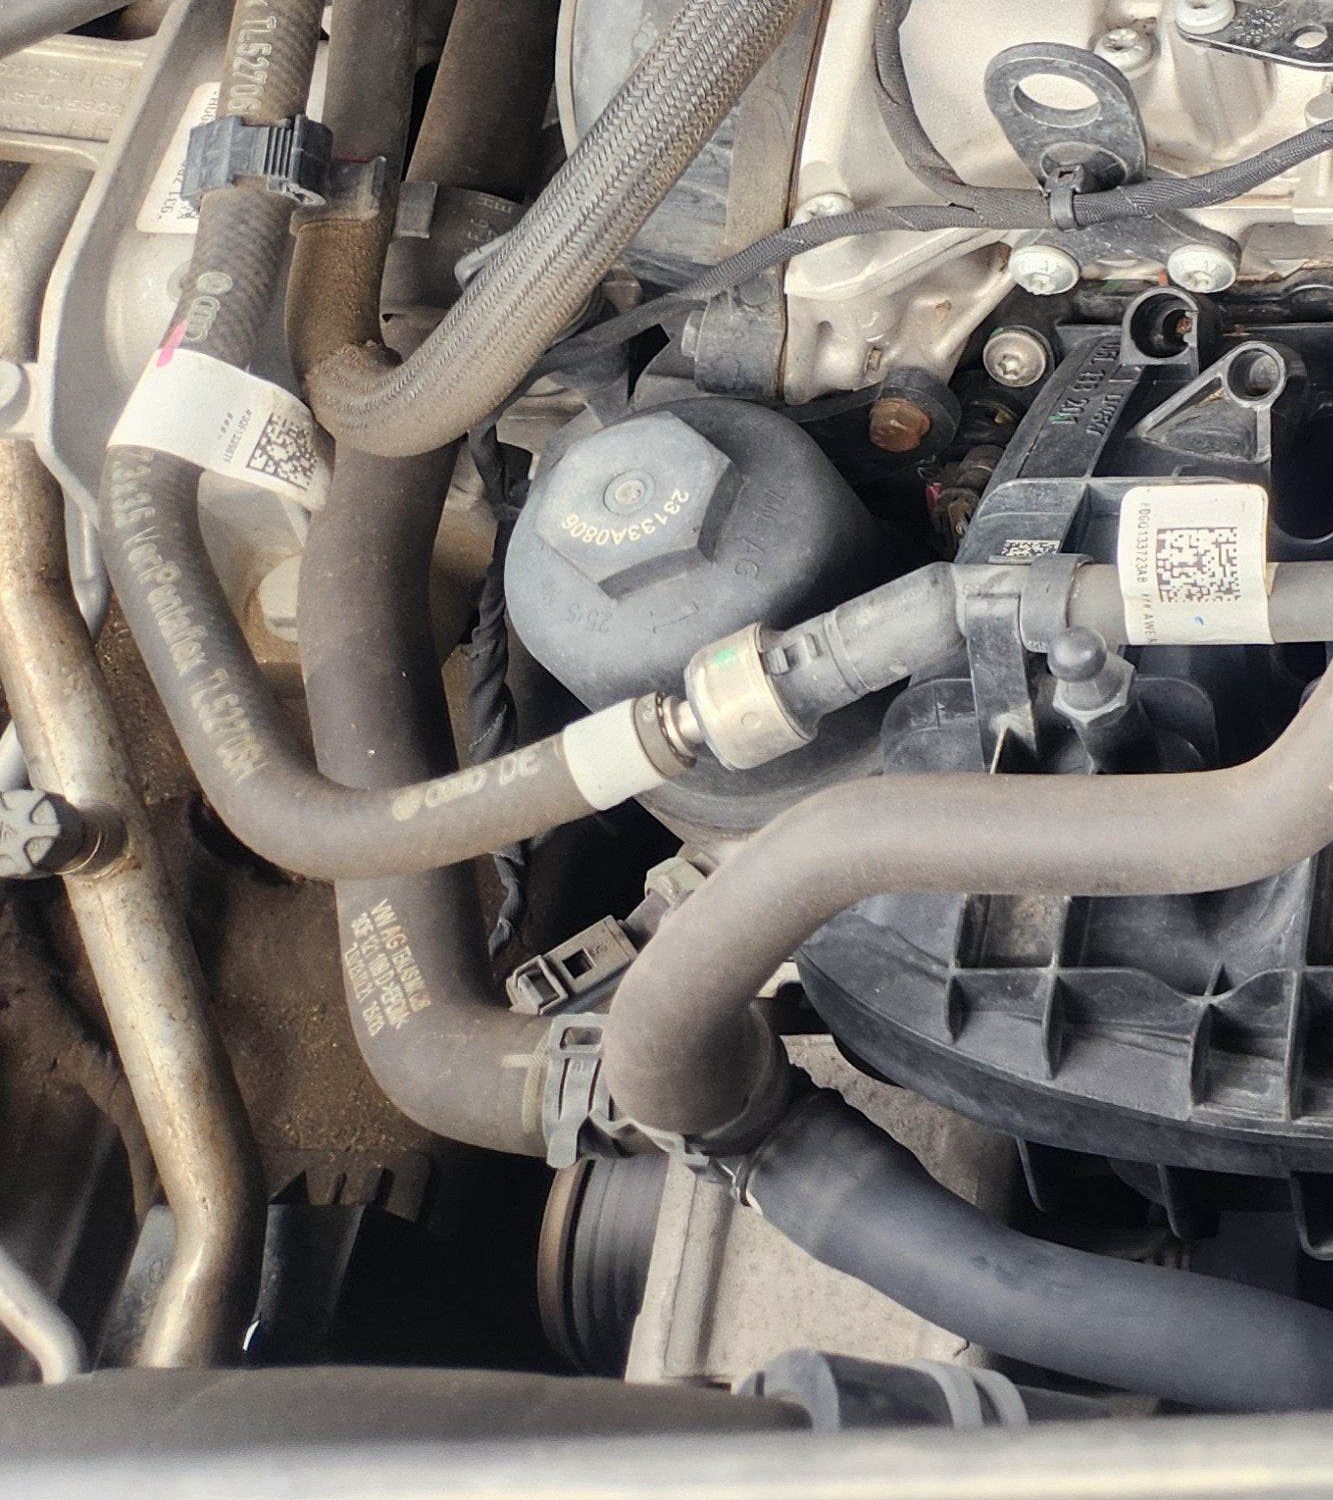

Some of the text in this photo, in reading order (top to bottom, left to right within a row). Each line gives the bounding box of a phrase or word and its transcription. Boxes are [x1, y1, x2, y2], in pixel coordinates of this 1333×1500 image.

[561, 487, 688, 545] 23133A0806
[370, 897, 397, 927] VW
[379, 922, 408, 951] AG
